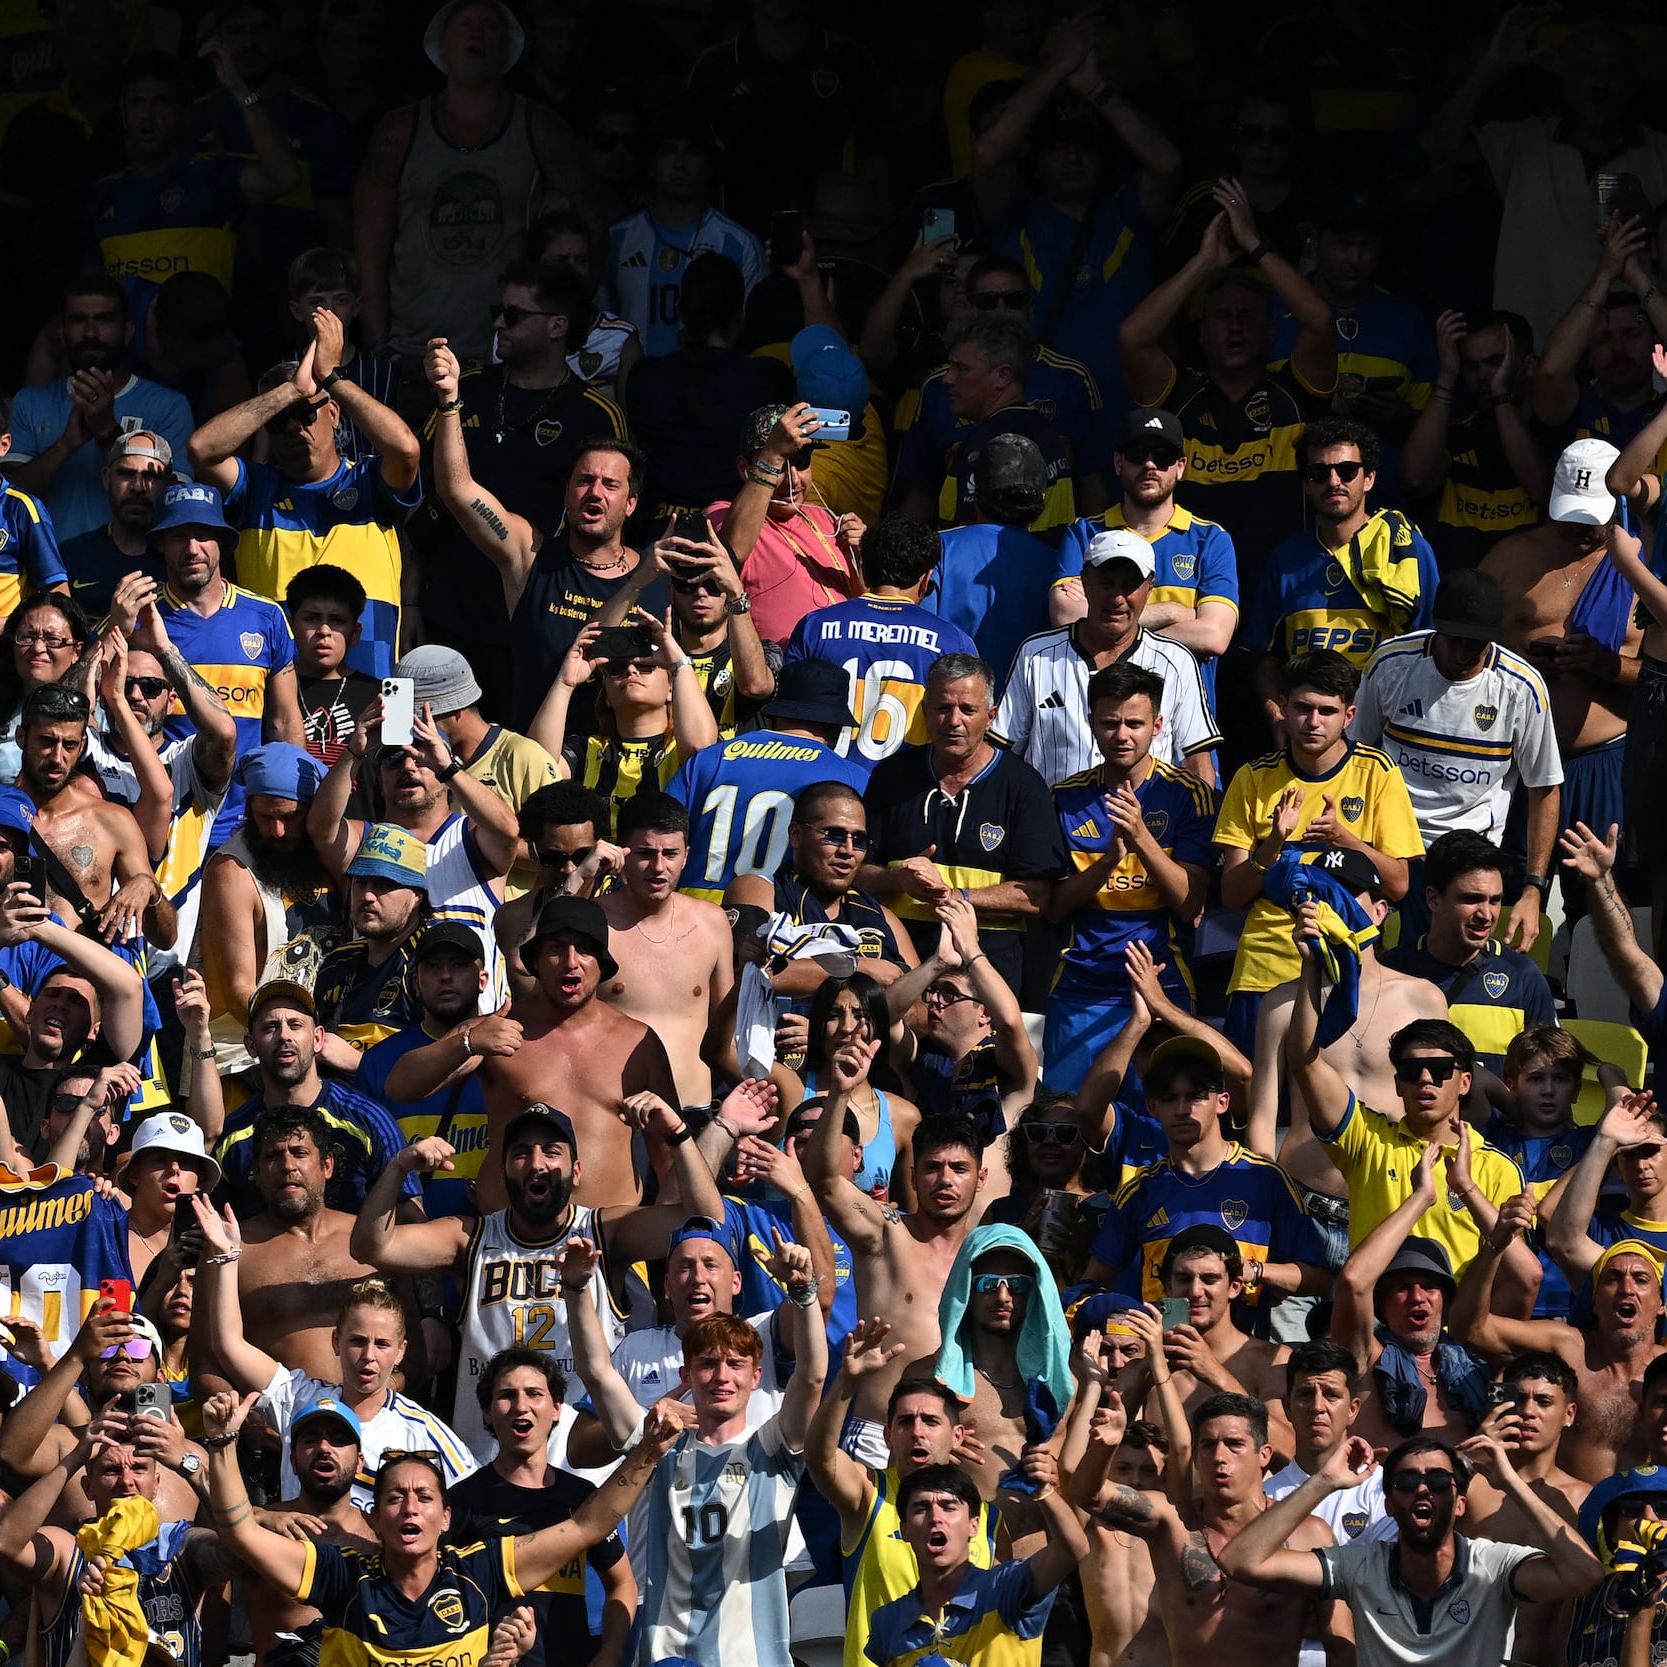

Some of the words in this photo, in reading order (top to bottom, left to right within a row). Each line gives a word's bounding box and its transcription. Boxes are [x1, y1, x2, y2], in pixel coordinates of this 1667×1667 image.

[1575, 468, 1591, 486] H
[166, 487, 215, 504] CABJ
[1174, 560, 1194, 570] CABJ
[821, 621, 842, 640] M.
[847, 621, 940, 651] MERENTIEL
[1474, 711, 1496, 721] CABJ
[723, 738, 821, 763] Quilmes
[1398, 750, 1491, 785] betsson
[1342, 802, 1363, 812] CABJ
[701, 785, 795, 886] 10
[981, 829, 1001, 840] CABJ
[1485, 977, 1507, 987] CABJ
[481, 1259, 568, 1306] BOC
[512, 1306, 557, 1350] 12
[681, 1504, 727, 1545] 10
[143, 1596, 184, 1621] JRS
[440, 1604, 460, 1616] CABJ
